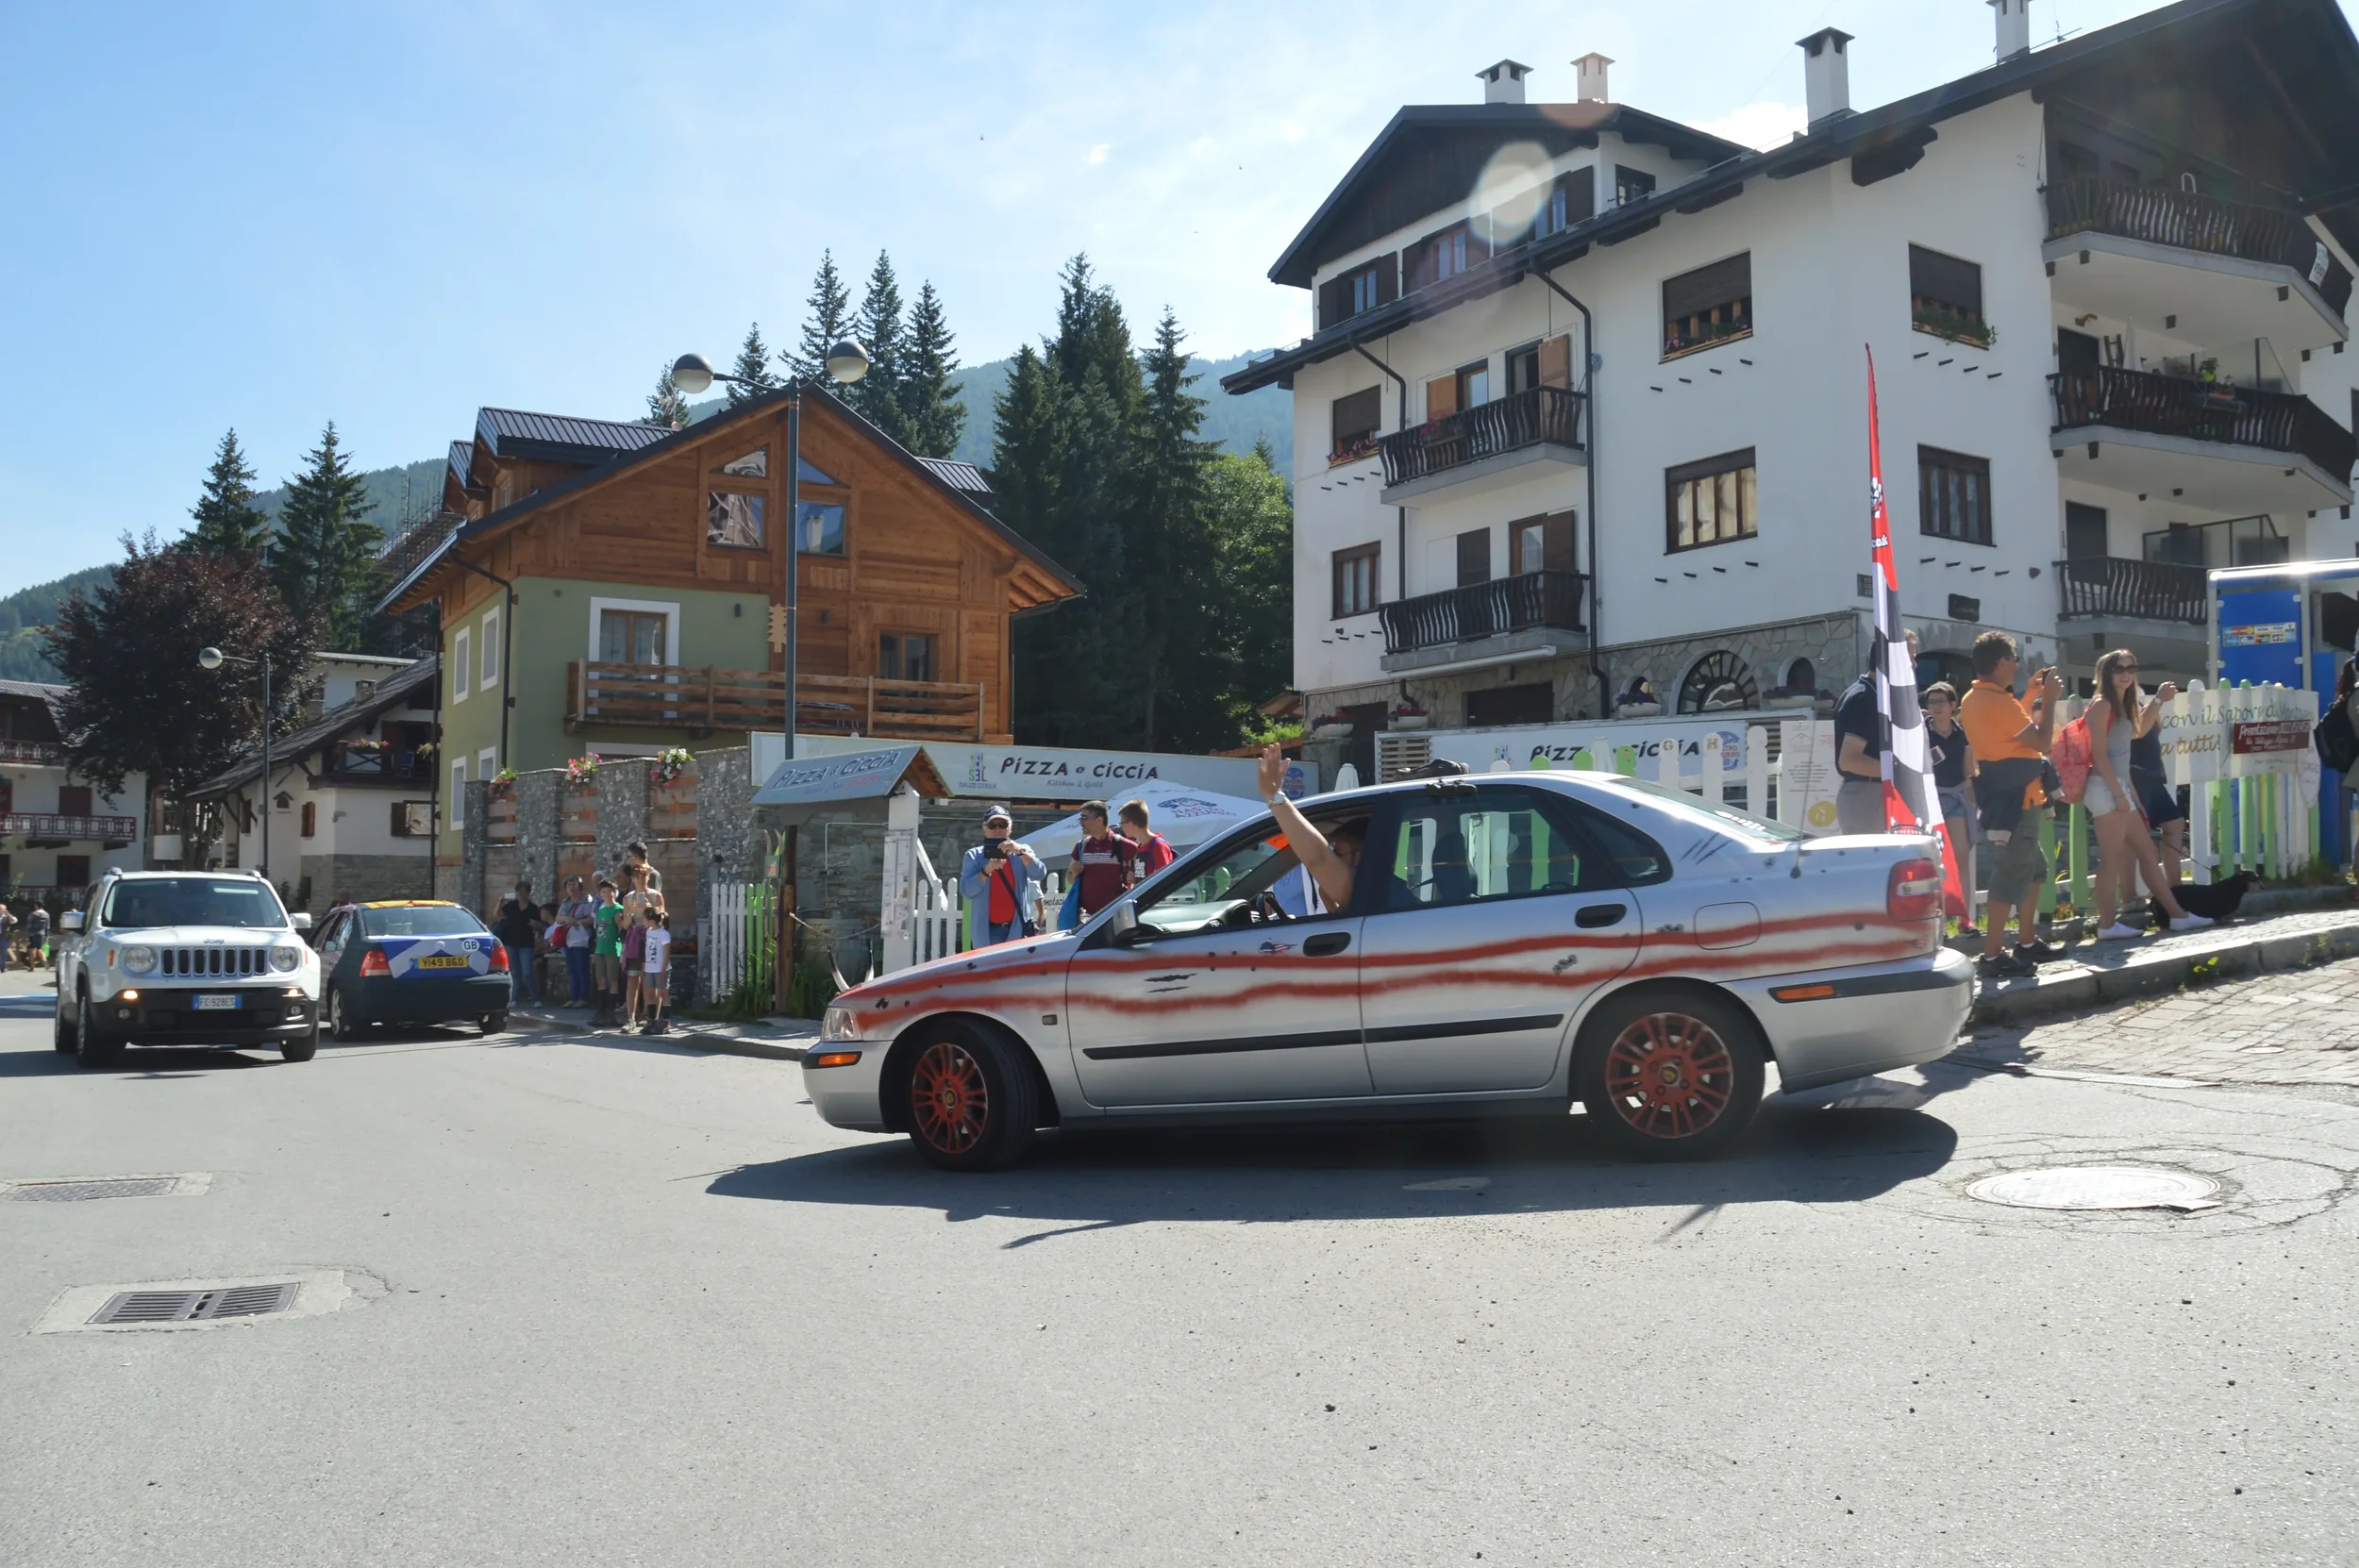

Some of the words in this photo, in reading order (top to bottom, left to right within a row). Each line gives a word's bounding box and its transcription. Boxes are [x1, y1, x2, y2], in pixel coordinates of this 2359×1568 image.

[2161, 713, 2199, 729] con
[2201, 705, 2216, 725] il
[1530, 745, 1584, 761] PiZZ
[2177, 734, 2221, 755] tutti!
[1000, 757, 1068, 776] PiZZA
[1093, 761, 1159, 779] CiCCiA
[463, 940, 478, 950] GB
[422, 958, 443, 967] Y149
